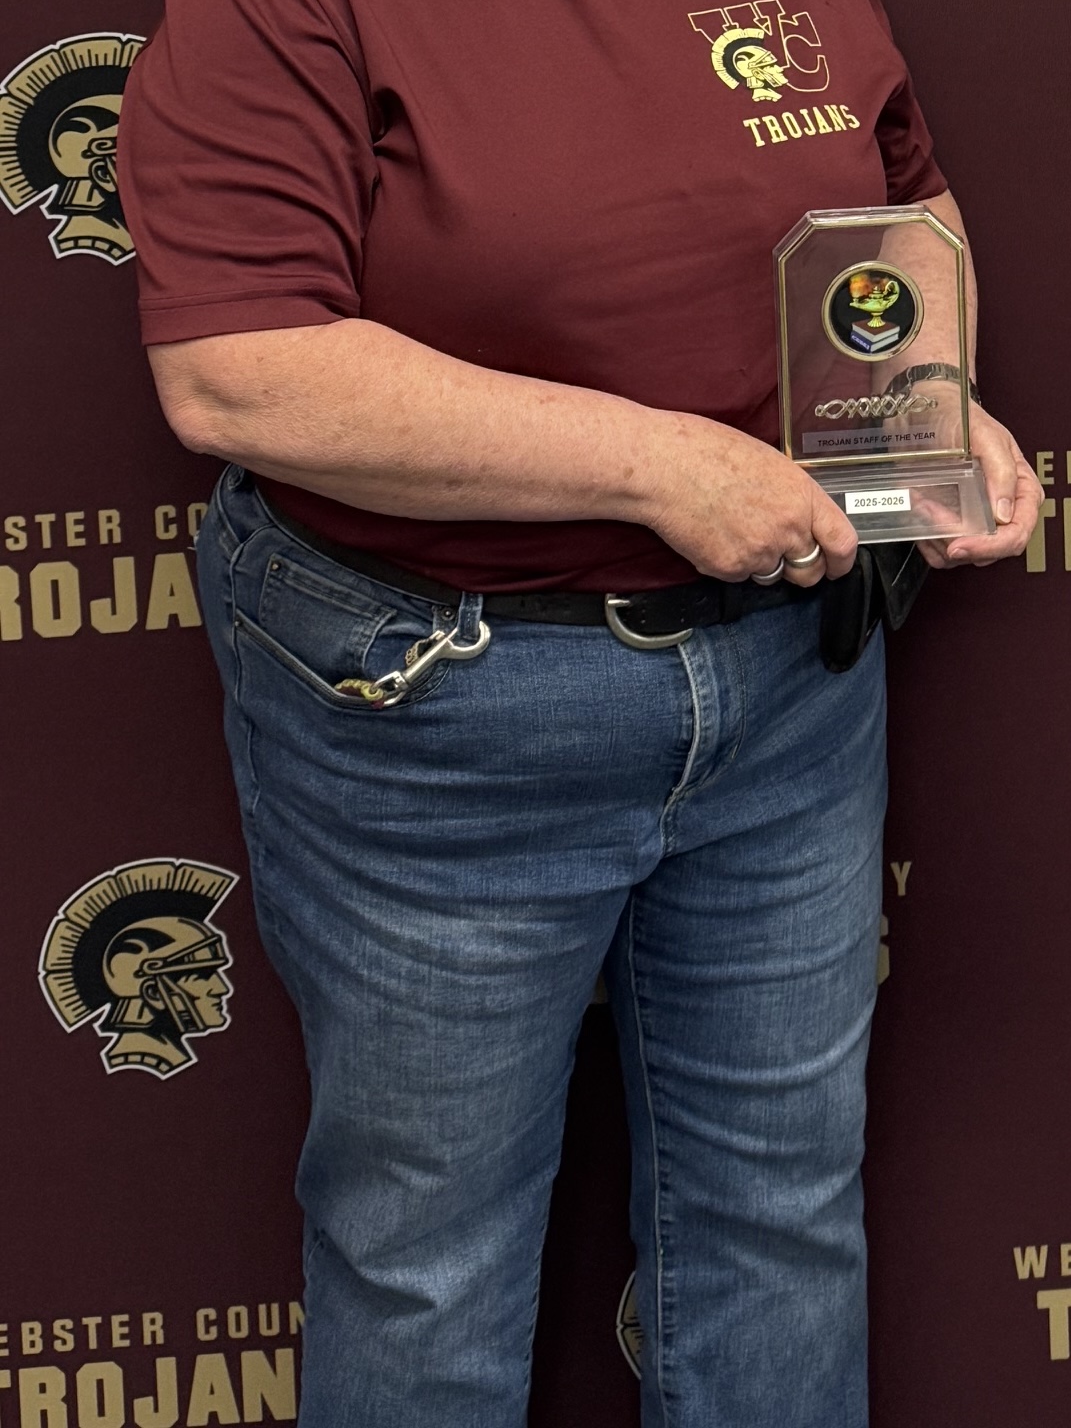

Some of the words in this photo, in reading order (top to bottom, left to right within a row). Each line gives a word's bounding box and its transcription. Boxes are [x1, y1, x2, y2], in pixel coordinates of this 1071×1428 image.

[742, 104, 861, 147] TROJANS
[817, 439, 852, 448] TROJAN
[853, 435, 880, 445] STAFF
[881, 434, 893, 443] OF
[895, 433, 911, 442] THE
[912, 431, 936, 441] YEAR
[854, 496, 905, 508] 2025-2026
[4, 508, 122, 552] STER
[154, 502, 209, 541] CO
[0, 1347, 298, 1428] ROJAN
